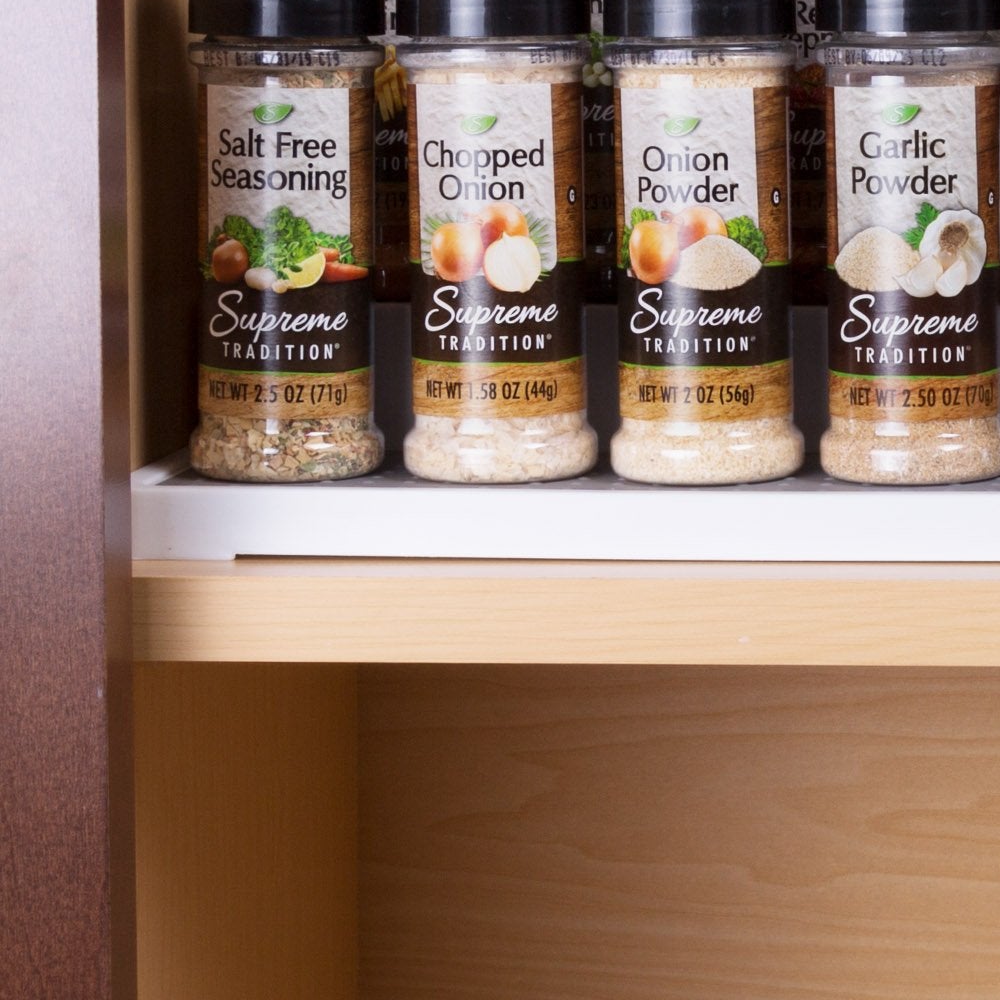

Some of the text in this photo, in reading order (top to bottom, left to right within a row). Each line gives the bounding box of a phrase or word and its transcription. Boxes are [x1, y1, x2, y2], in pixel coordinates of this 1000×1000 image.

[219, 128, 337, 158] Salt Free
[423, 138, 545, 177] Chopped
[859, 129, 946, 159] Garlic
[642, 145, 729, 172] Onion
[211, 158, 347, 199] Seasoning
[439, 173, 525, 200] Onion
[637, 175, 739, 204] Powder
[851, 165, 958, 195] Powder
[209, 289, 349, 343] Supreme
[424, 285, 559, 335] Supreme
[630, 287, 762, 338] Supreme
[840, 293, 979, 347] Supreme
[854, 345, 965, 364] TRADITION
[209, 379, 347, 406] NET WT 2.5 OZ (71g)
[426, 380, 558, 401] NET WT 1.58 OZ (44g)
[639, 384, 755, 406] NET WT 2 OZ (56g)
[850, 383, 994, 408] NET WT 2.50 OZ (70g)
